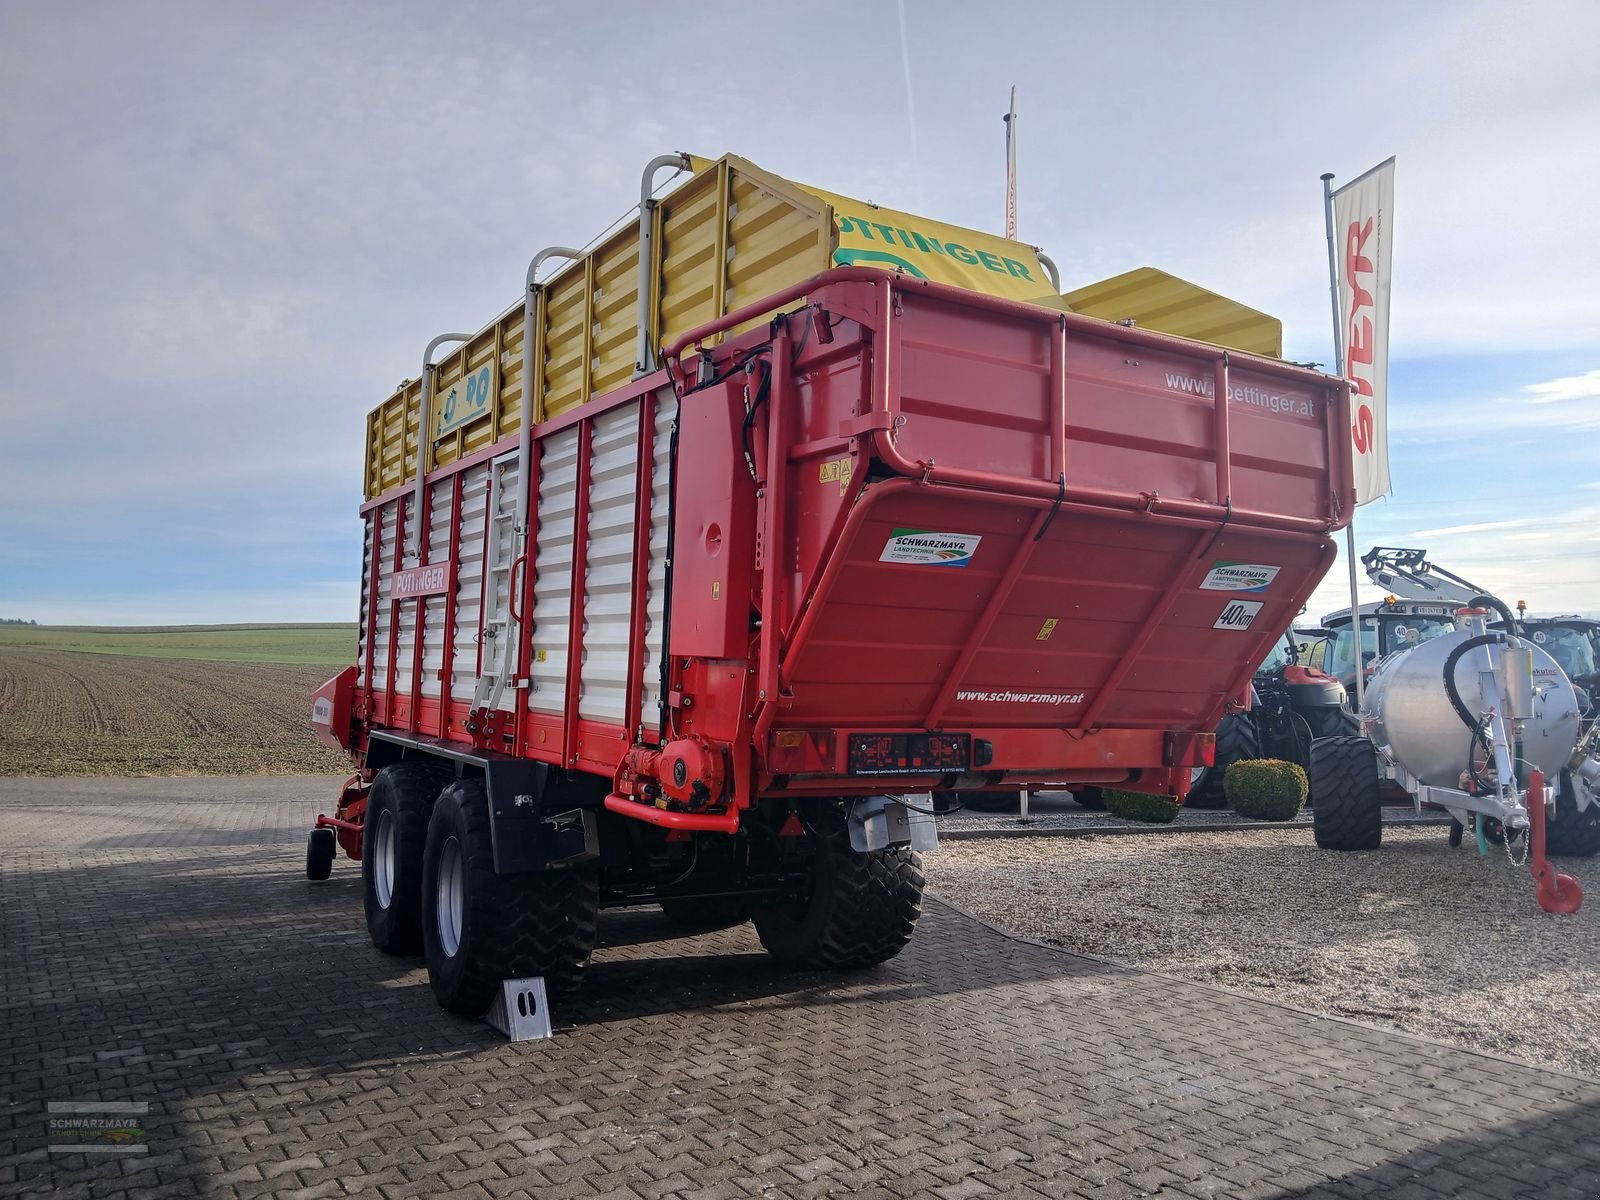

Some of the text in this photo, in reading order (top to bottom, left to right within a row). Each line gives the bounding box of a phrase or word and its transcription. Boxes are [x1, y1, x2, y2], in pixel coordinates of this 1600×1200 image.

[1346, 215, 1374, 455] STEYR
[895, 537, 966, 550] SCHWARZMAYR
[893, 546, 936, 555] LANDTECHNIK
[1215, 568, 1268, 579] SCHWARZMAYR
[1397, 627, 1406, 637] 40
[956, 690, 1085, 706] www.schwarzmayr.at
[1540, 693, 1548, 703] V
[1536, 711, 1543, 720] H
